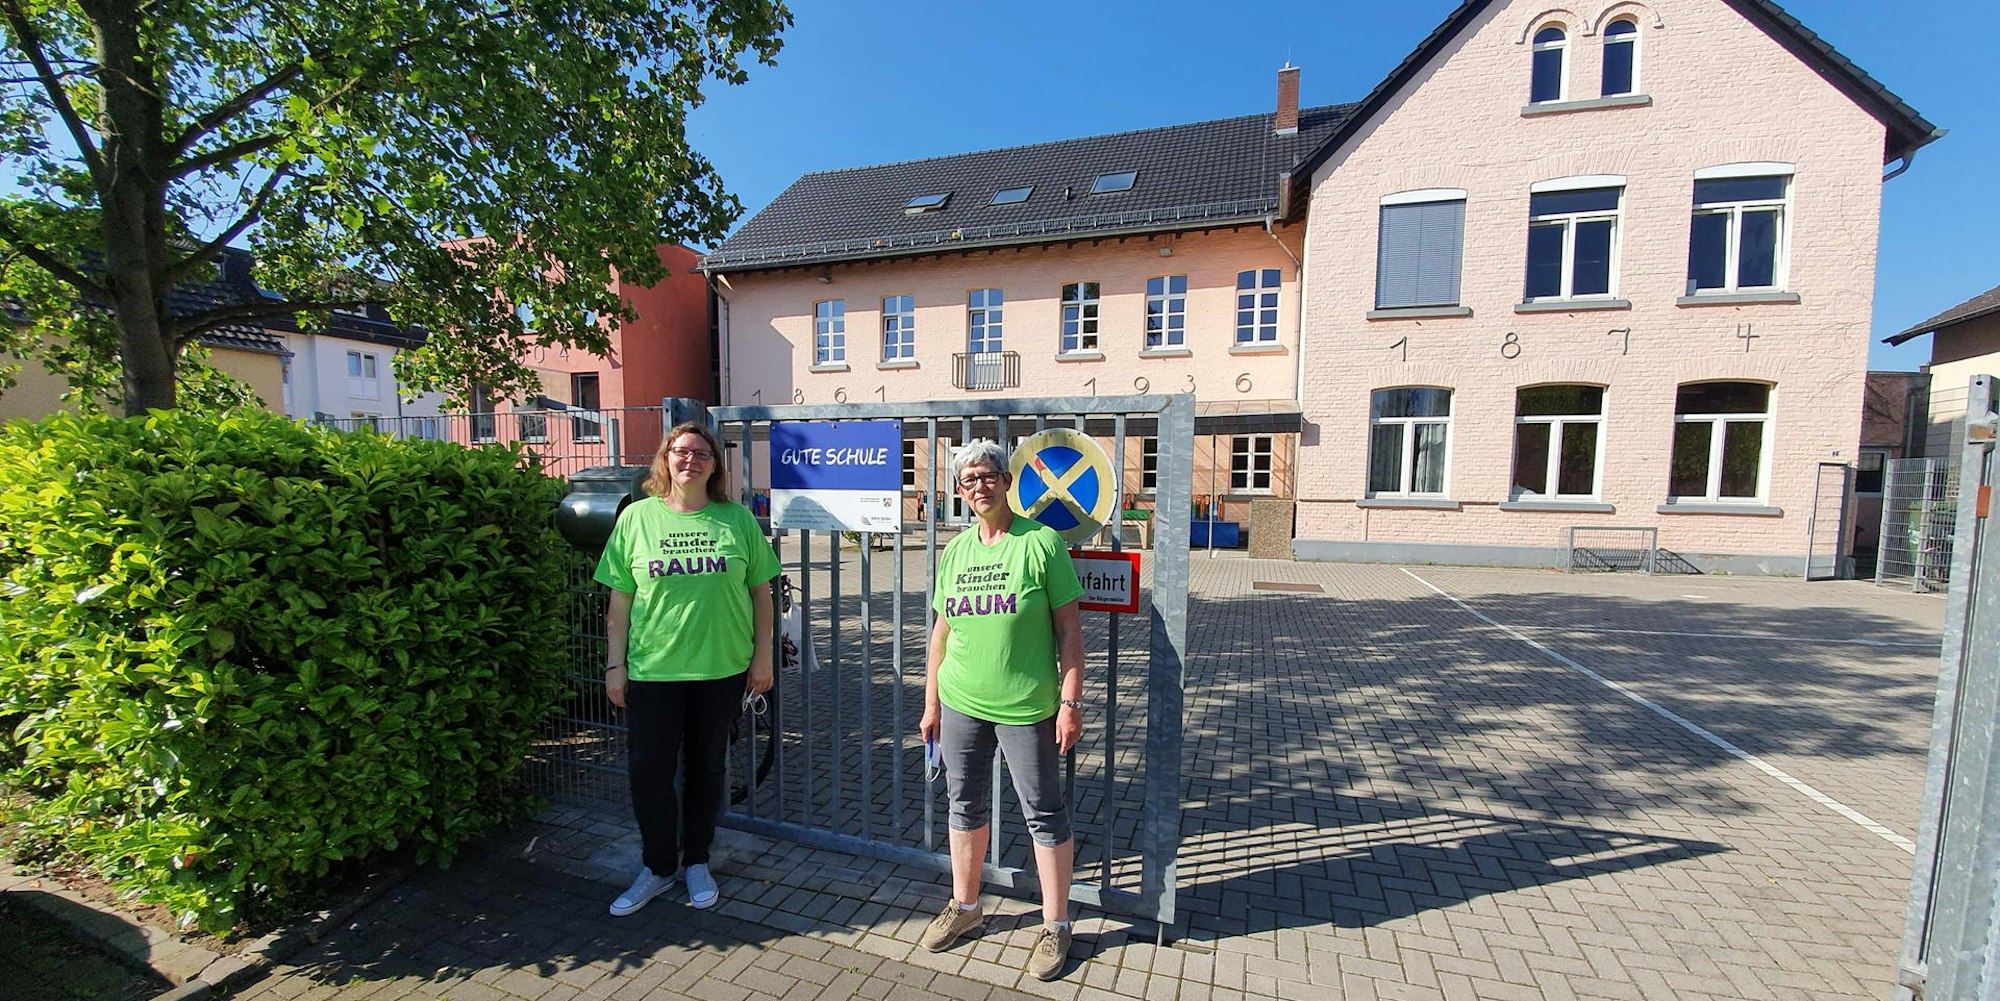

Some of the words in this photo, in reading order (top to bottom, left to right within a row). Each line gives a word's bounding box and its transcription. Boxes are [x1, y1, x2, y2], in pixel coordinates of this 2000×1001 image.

[781, 448, 823, 465] GUTE
[825, 447, 890, 466] SCHULE
[659, 538, 717, 548] Kinder
[662, 547, 716, 555] brauchen
[648, 556, 727, 578] RAUM
[967, 563, 1003, 573] unsere
[955, 571, 1010, 585] Kinder
[1078, 571, 1126, 591] ufahrt
[957, 584, 1006, 593] brauchen
[945, 593, 1017, 618] RAUM
